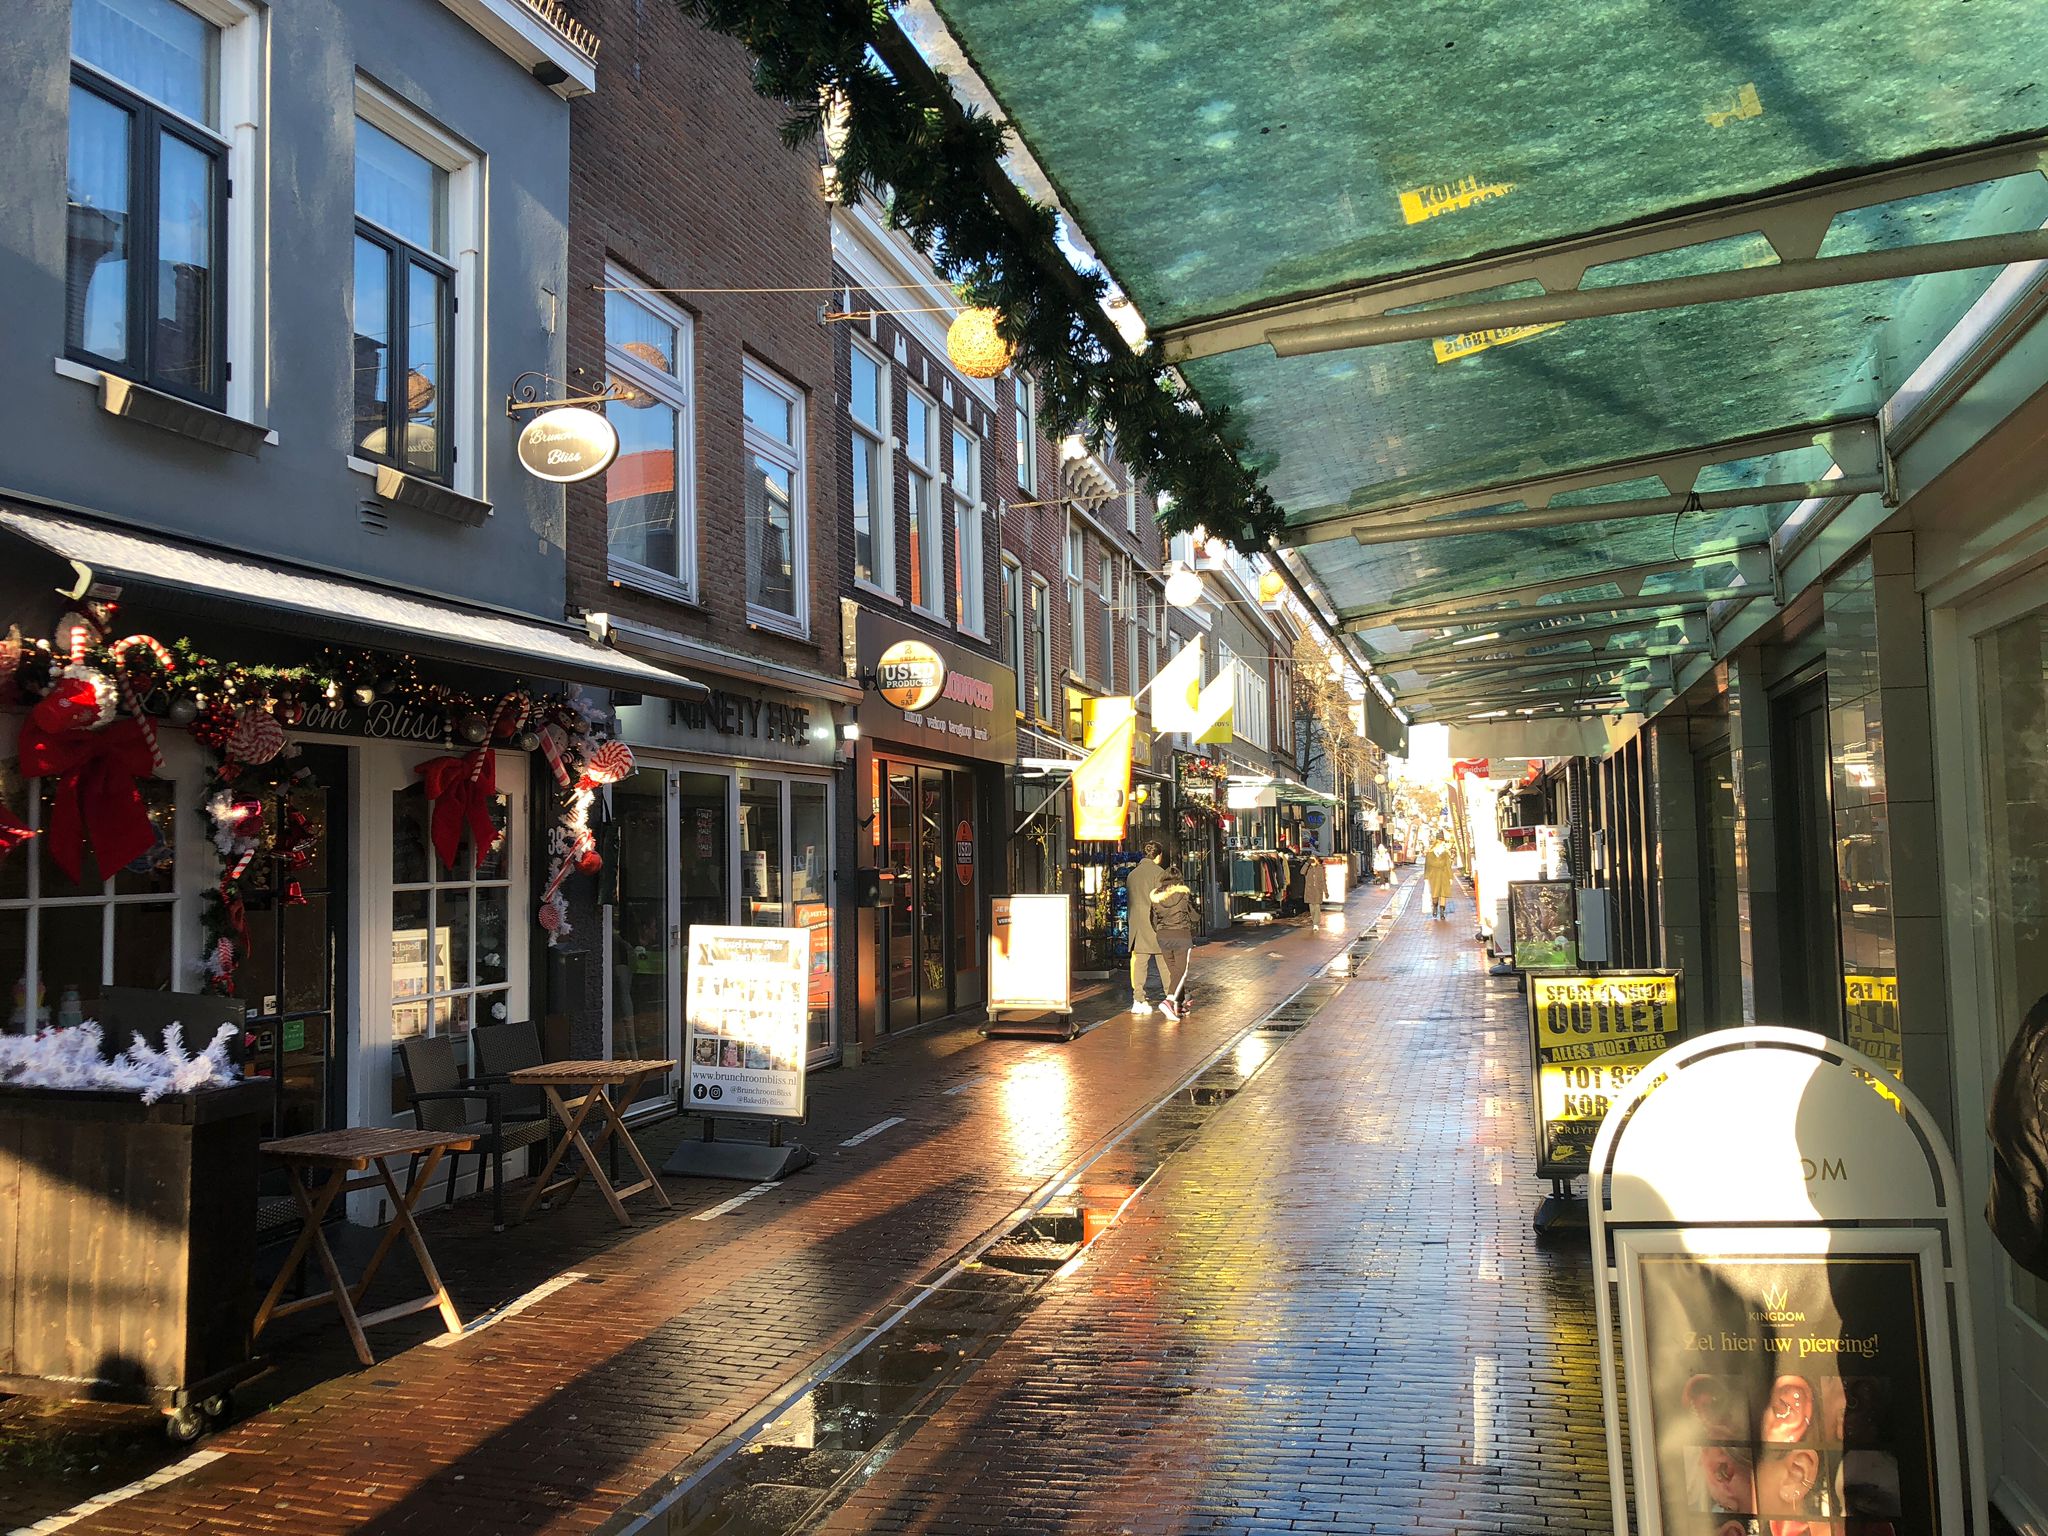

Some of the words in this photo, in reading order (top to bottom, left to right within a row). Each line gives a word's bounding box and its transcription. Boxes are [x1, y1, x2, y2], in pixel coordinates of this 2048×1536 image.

[547, 448, 582, 465] Bliss
[884, 662, 936, 681] USED
[885, 679, 934, 689] PRODUCTS
[363, 699, 442, 741] Bliss
[668, 689, 763, 739] NINETY
[768, 701, 811, 747] FIVE
[1546, 984, 1594, 1001] SPORT
[1547, 999, 1668, 1035] OUTLET
[1551, 1043, 1593, 1063] ALLES
[1593, 1037, 1632, 1057] MOET
[1633, 1032, 1667, 1051] WEG
[692, 1070, 797, 1086] www.brunchroombliss.nl
[1561, 1065, 1603, 1090] TOT
[730, 1085, 792, 1097] @BrunchroomBliss
[736, 1095, 784, 1107] @BakedByBliss
[1749, 1311, 1806, 1322] KINGDOM
[1721, 1331, 1757, 1352] hier
[1764, 1337, 1791, 1352] uw
[1799, 1332, 1880, 1358] piercing!
